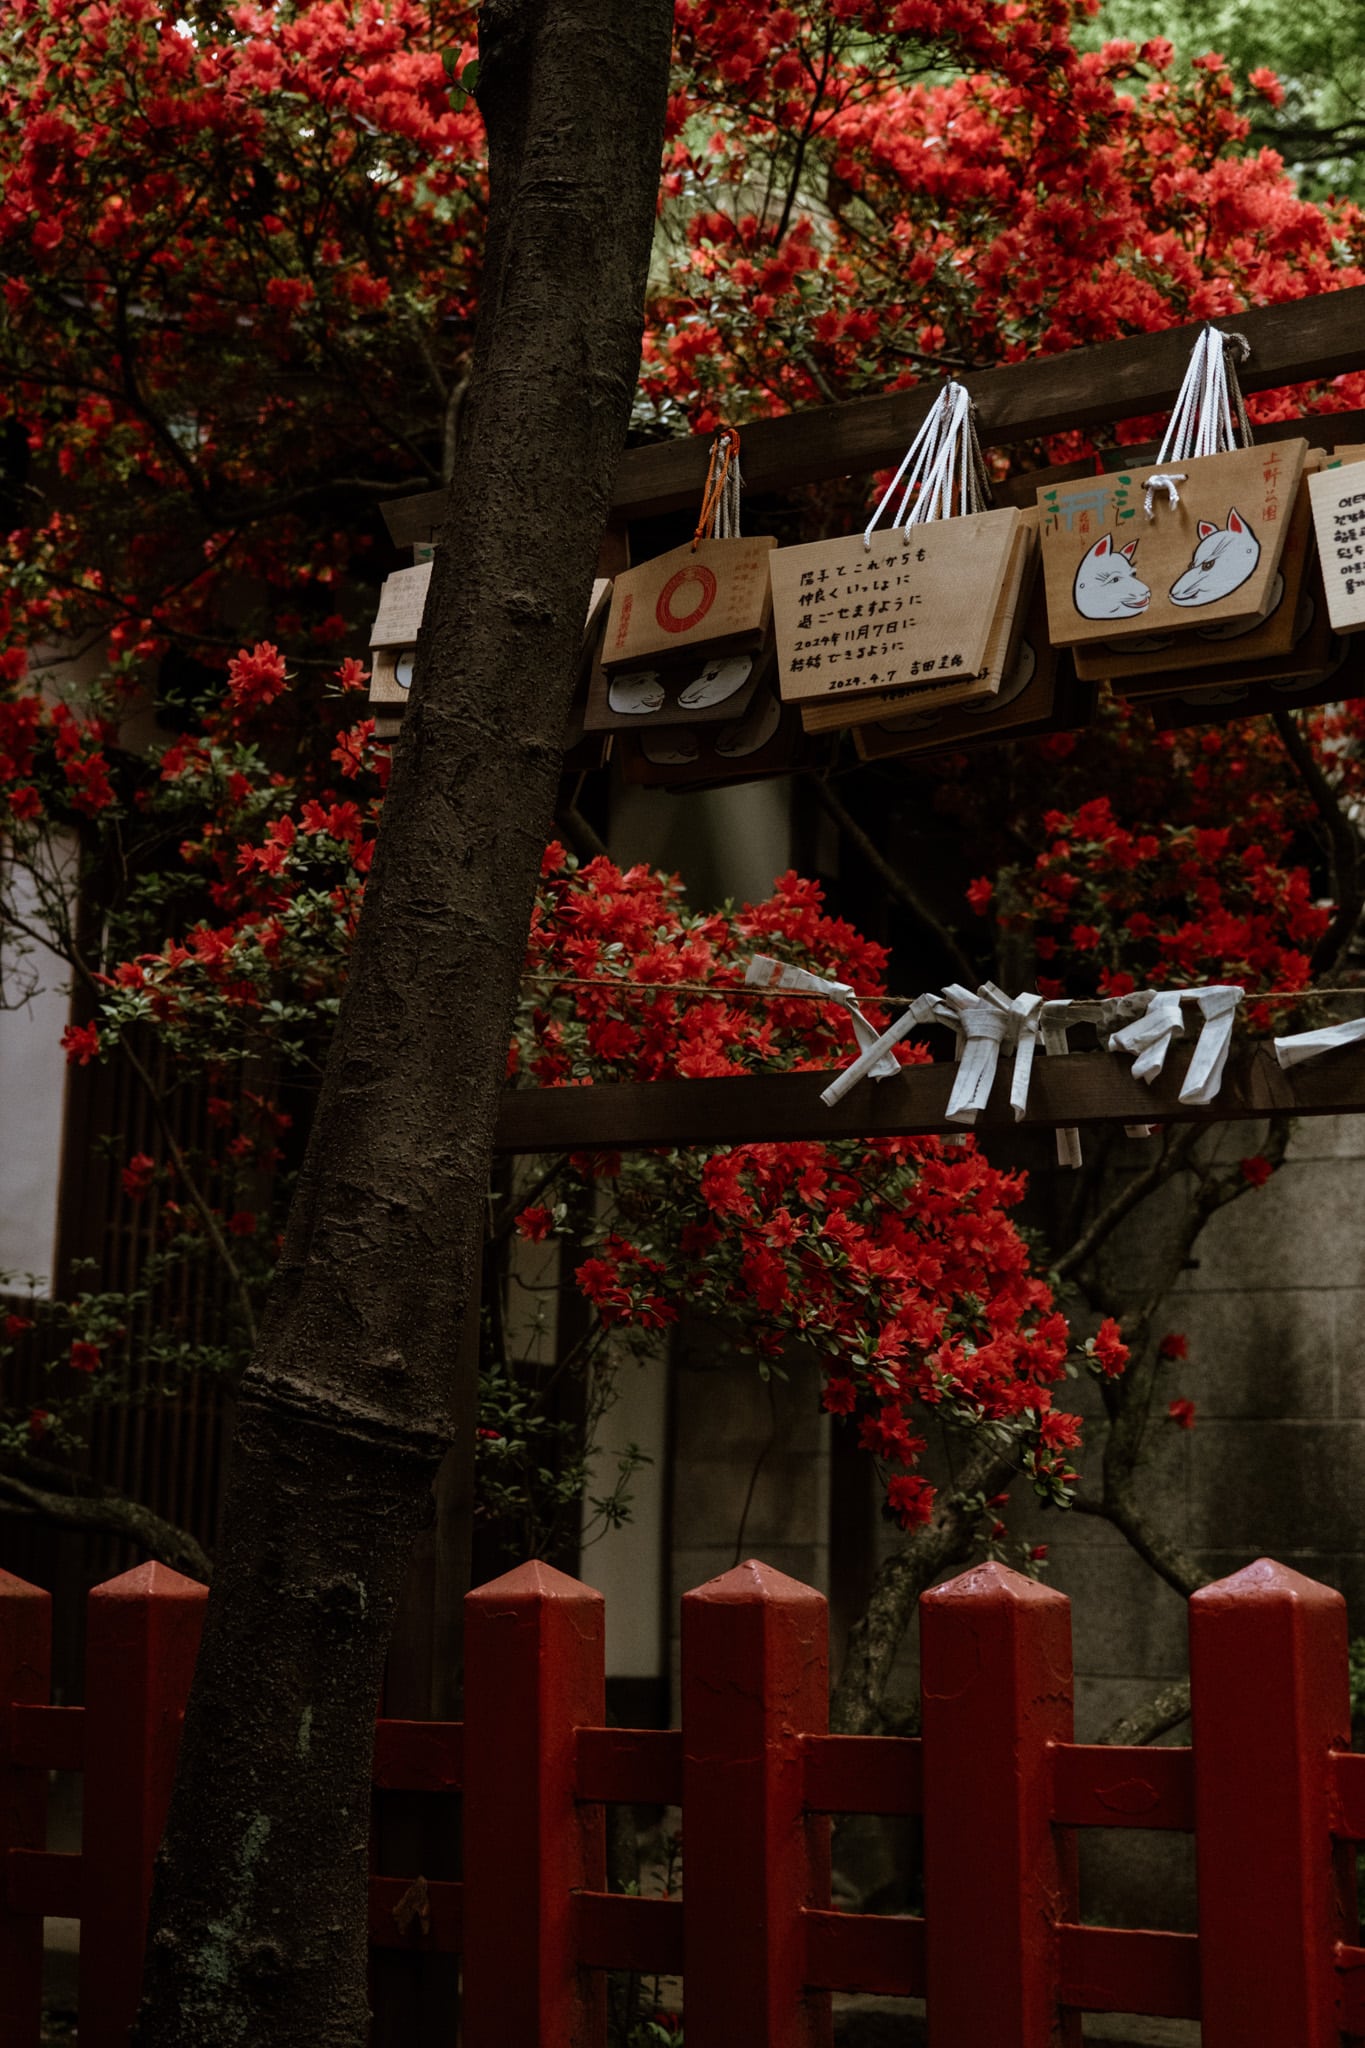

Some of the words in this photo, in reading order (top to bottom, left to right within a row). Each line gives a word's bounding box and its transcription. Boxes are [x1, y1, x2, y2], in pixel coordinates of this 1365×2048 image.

[797, 595, 922, 629] 過ごせますように
[790, 642, 904, 672] 結婚できるように
